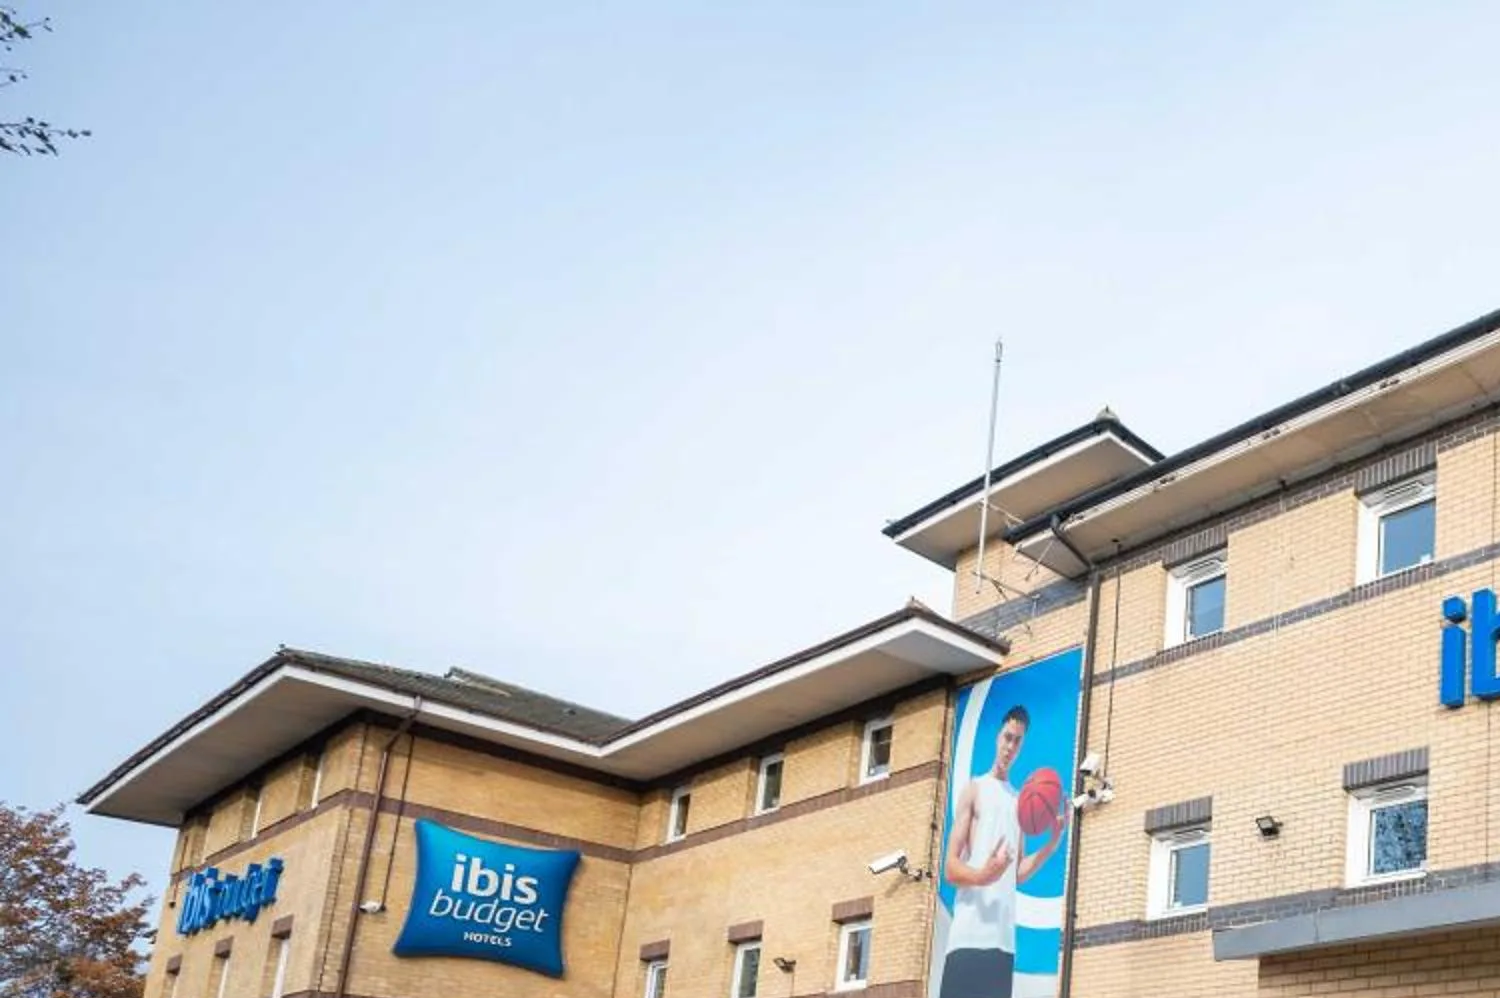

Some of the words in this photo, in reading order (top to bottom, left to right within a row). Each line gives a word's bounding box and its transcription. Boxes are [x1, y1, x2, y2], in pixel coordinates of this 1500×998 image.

[451, 853, 538, 905] ibis
[429, 888, 549, 933] budget
[463, 931, 513, 948] HOTELS
